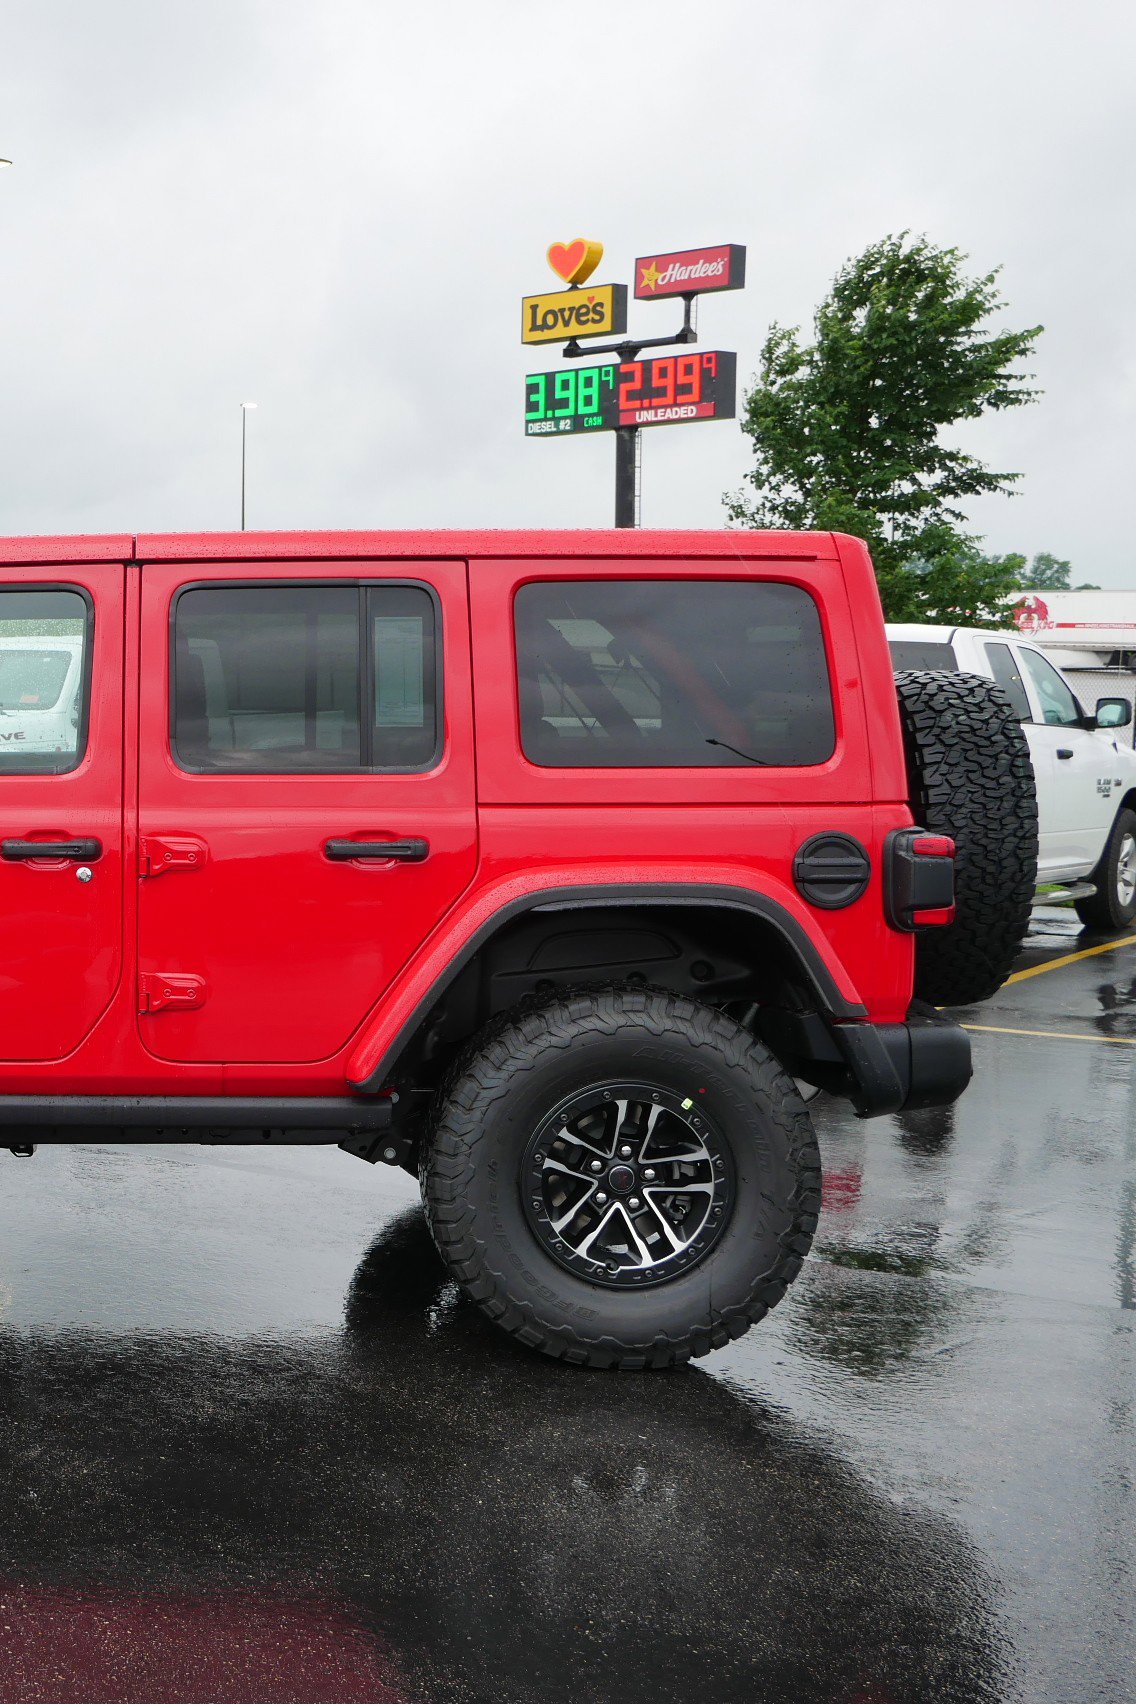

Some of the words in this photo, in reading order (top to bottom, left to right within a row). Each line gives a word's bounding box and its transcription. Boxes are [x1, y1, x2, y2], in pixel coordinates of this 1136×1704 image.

[657, 258, 725, 285] Hardee's
[584, 416, 603, 427] CASH
[635, 405, 697, 422] UNLEADED
[528, 422, 557, 434] DIESEL
[559, 419, 571, 430] #2
